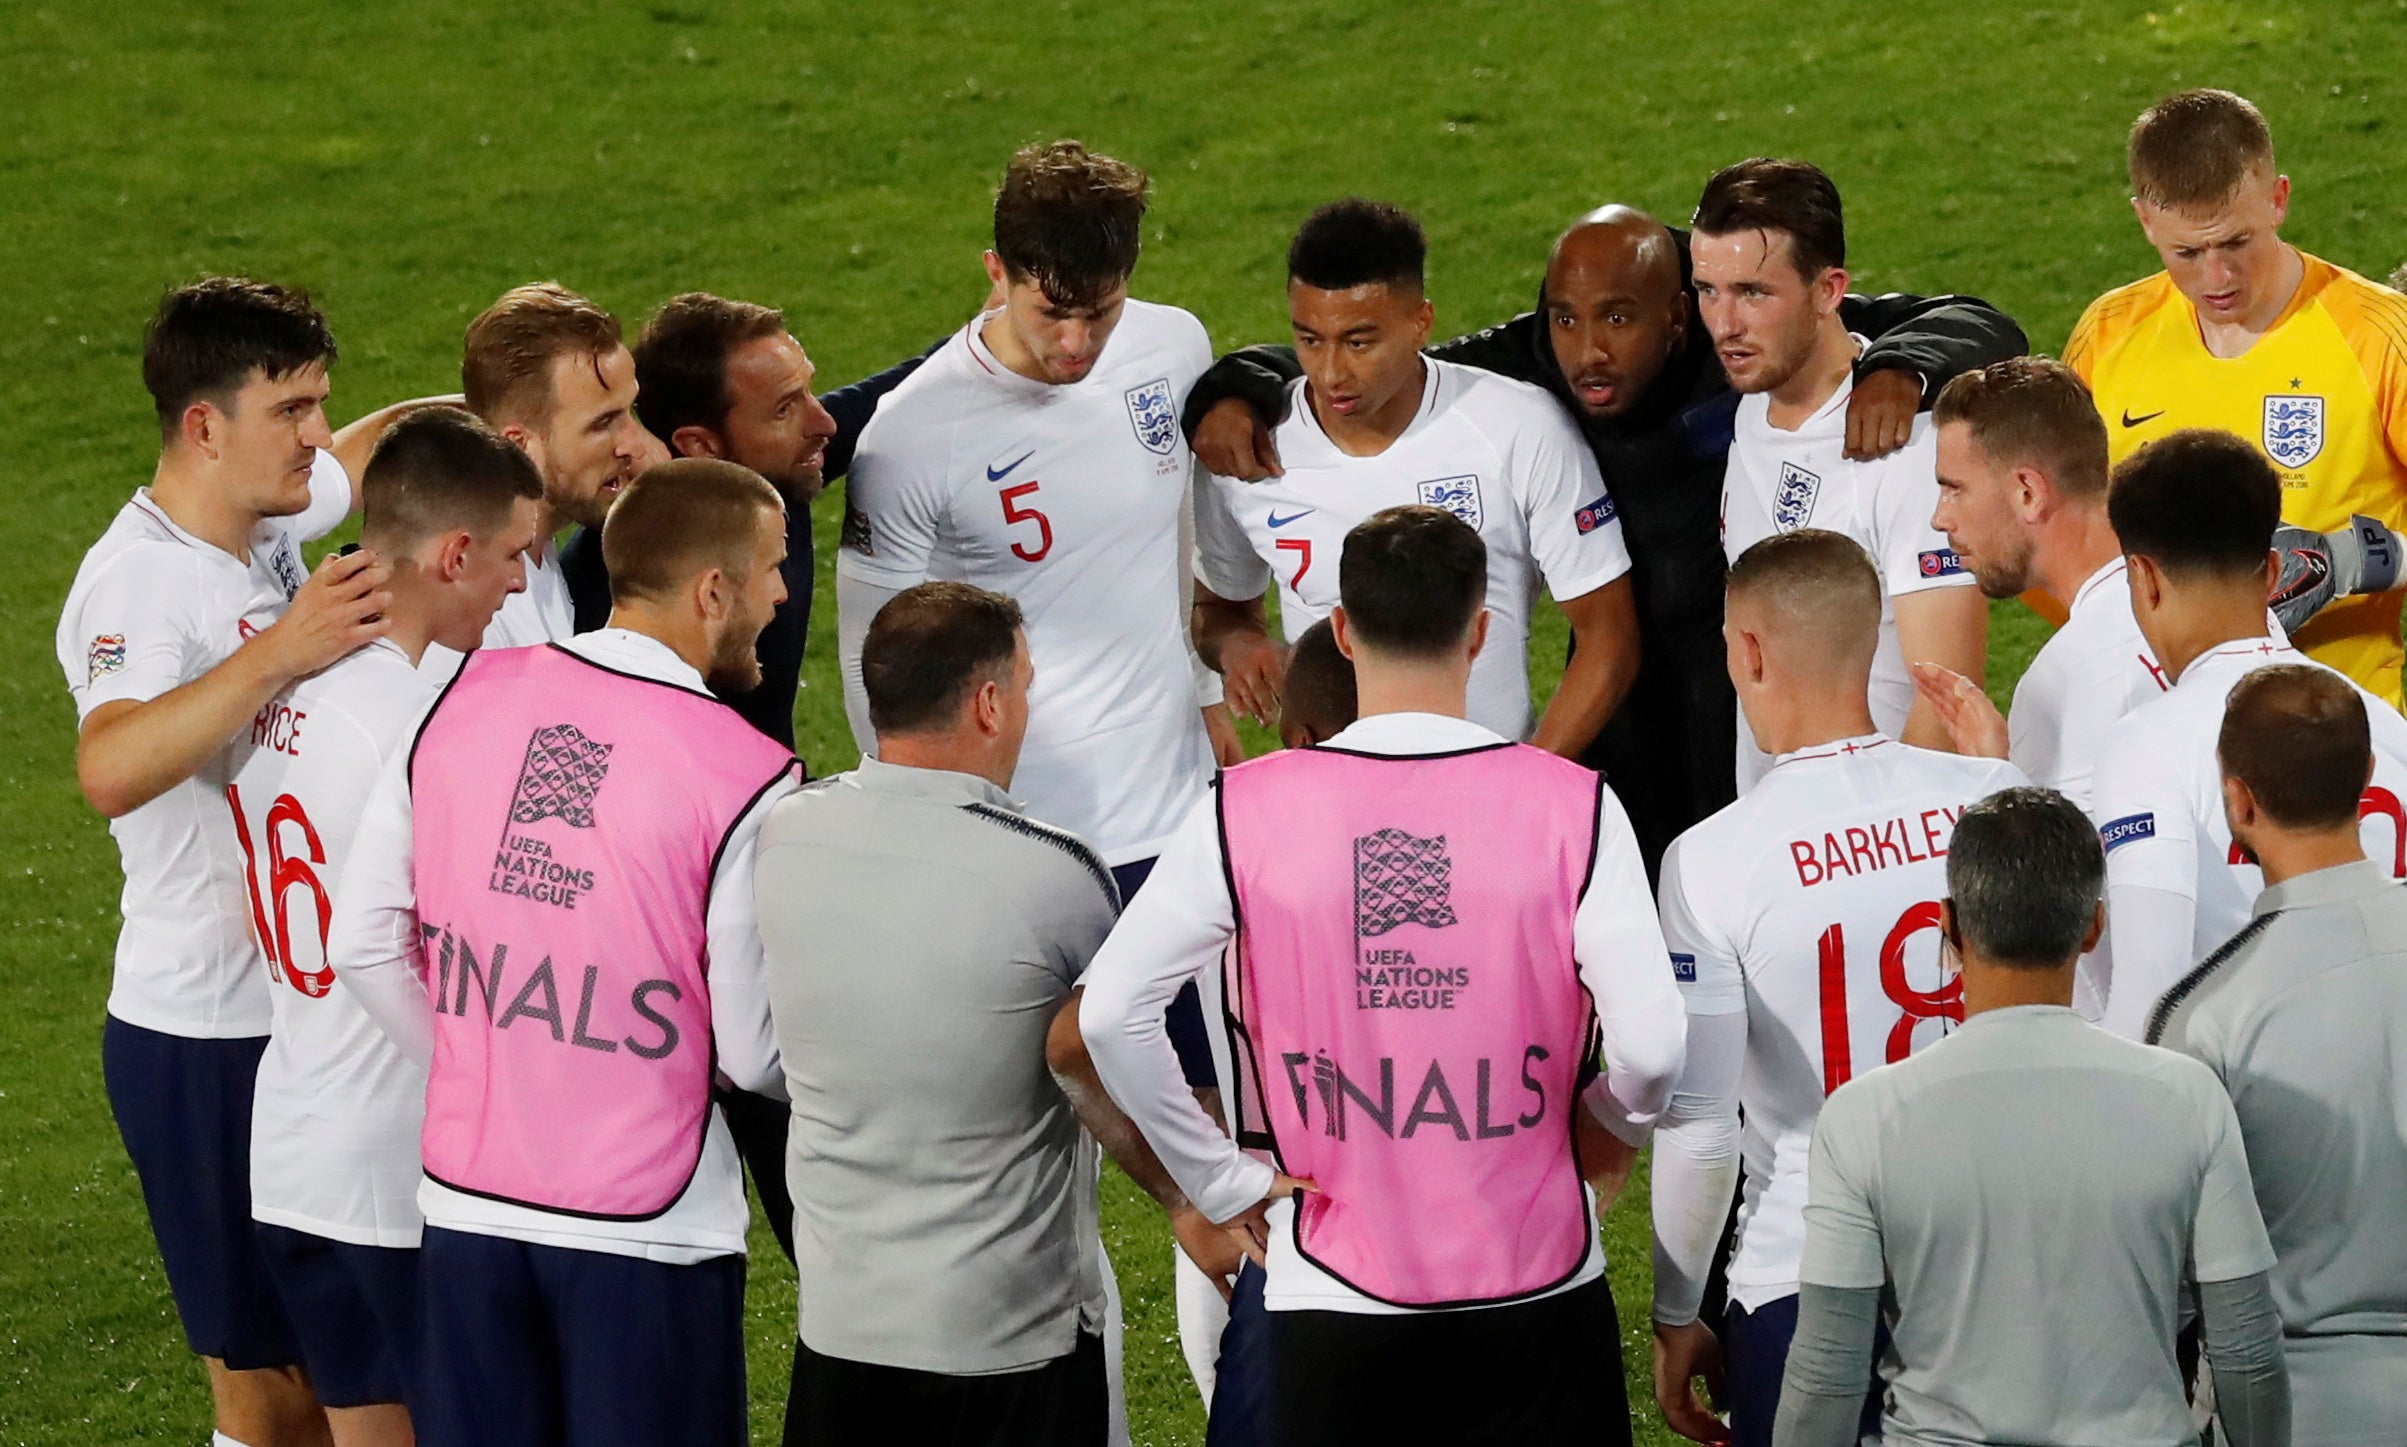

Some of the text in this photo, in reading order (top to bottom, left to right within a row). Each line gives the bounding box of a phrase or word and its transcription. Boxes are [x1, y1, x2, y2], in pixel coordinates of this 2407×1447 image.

[999, 480, 1053, 562] 5
[1275, 539, 1311, 592] 7
[2362, 527, 2389, 566] JP
[251, 702, 306, 756] RICE
[509, 835, 552, 858] UEFA
[225, 784, 336, 998] 16
[488, 872, 577, 910] LEAGUE
[494, 850, 595, 891] NATIONS
[1355, 967, 1469, 987] NATIONS
[1365, 950, 1416, 965] UEFA
[1356, 989, 1455, 1009] LEAGUE
[1817, 901, 1965, 1099] 18
[1281, 1048, 1549, 1142] FINALS
